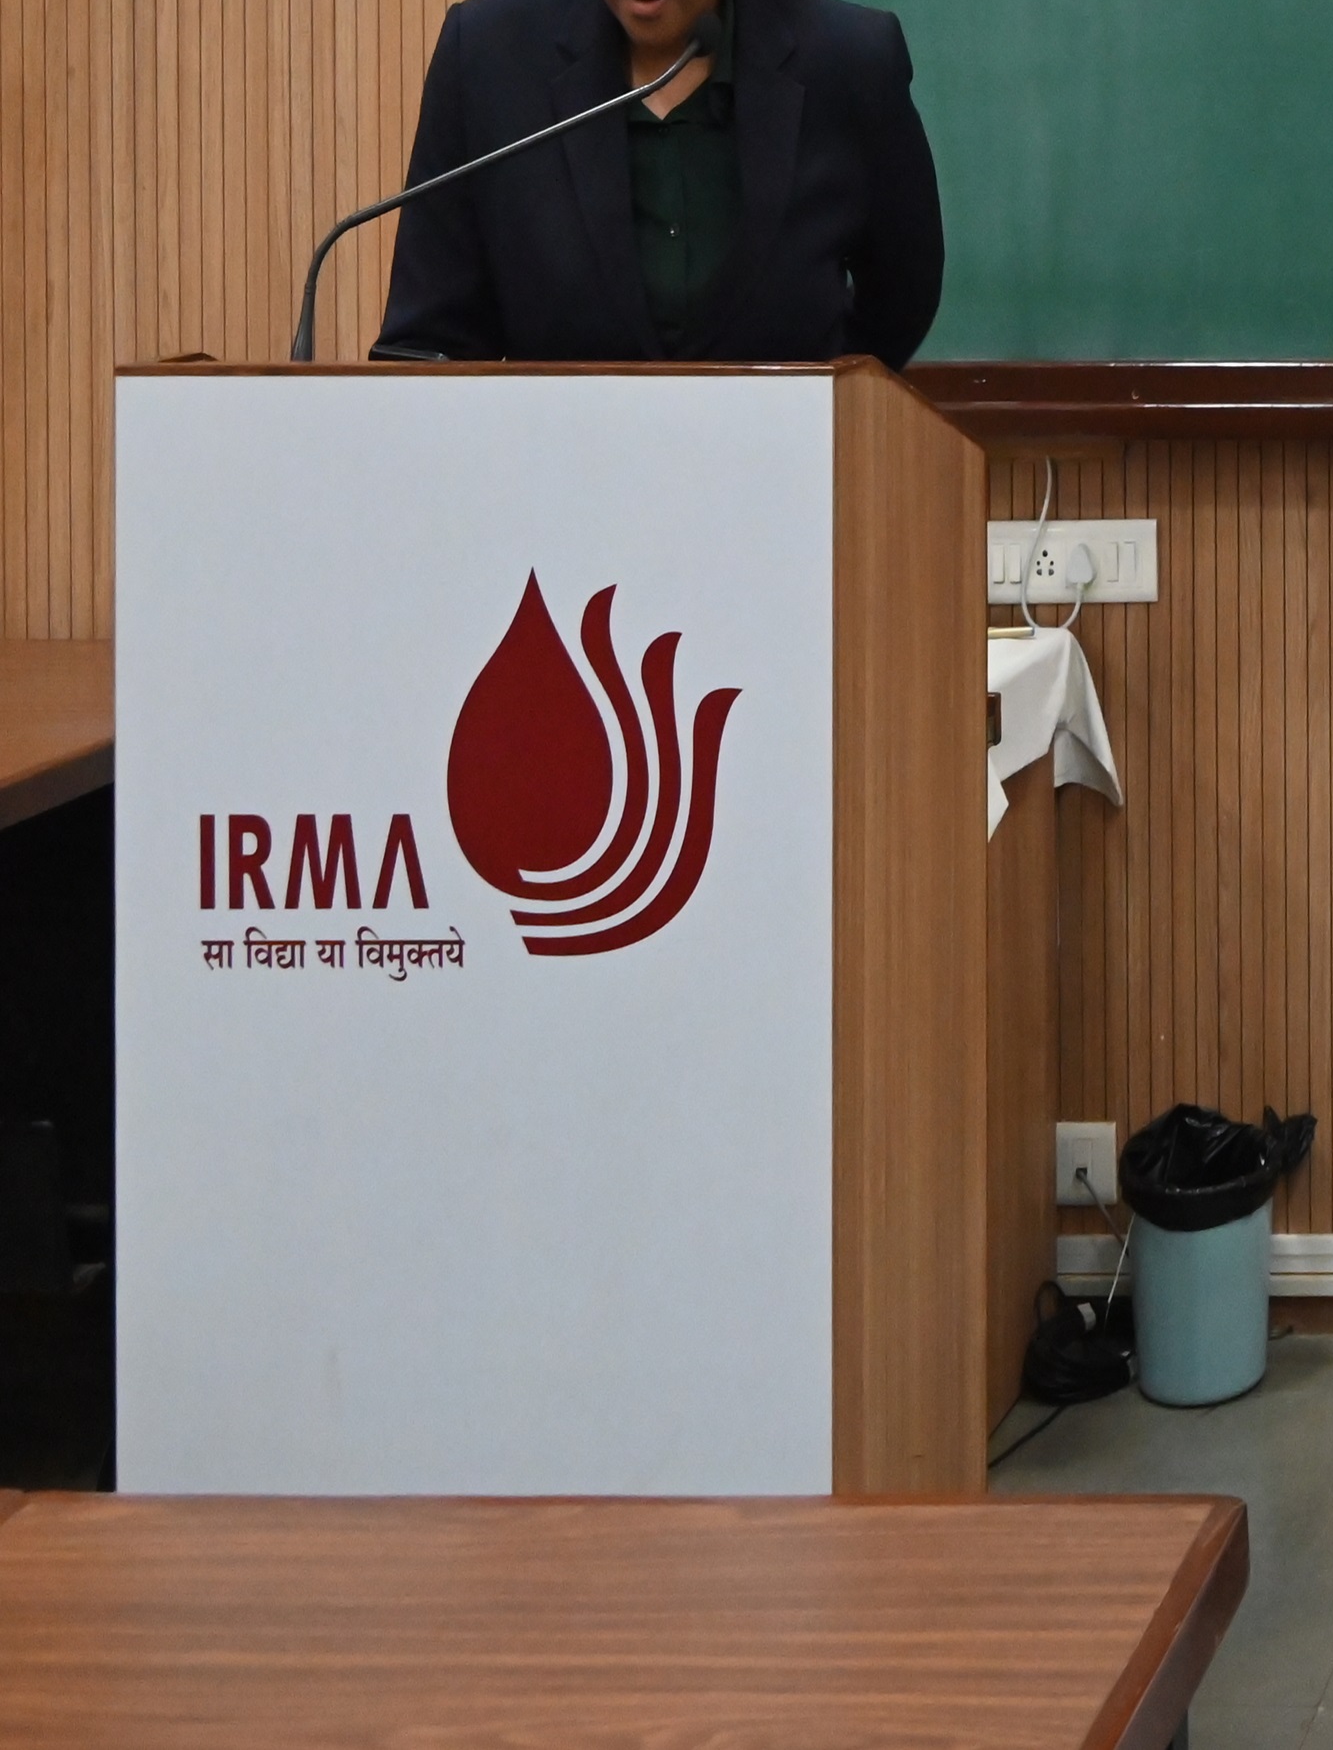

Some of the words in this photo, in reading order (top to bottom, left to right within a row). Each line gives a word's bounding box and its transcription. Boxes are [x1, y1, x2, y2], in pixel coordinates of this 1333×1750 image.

[200, 814, 429, 909] IRMA
[201, 940, 233, 970] सा
[243, 926, 305, 970] विद्या
[316, 939, 345, 969] या
[357, 926, 465, 981] विमुक्तये
